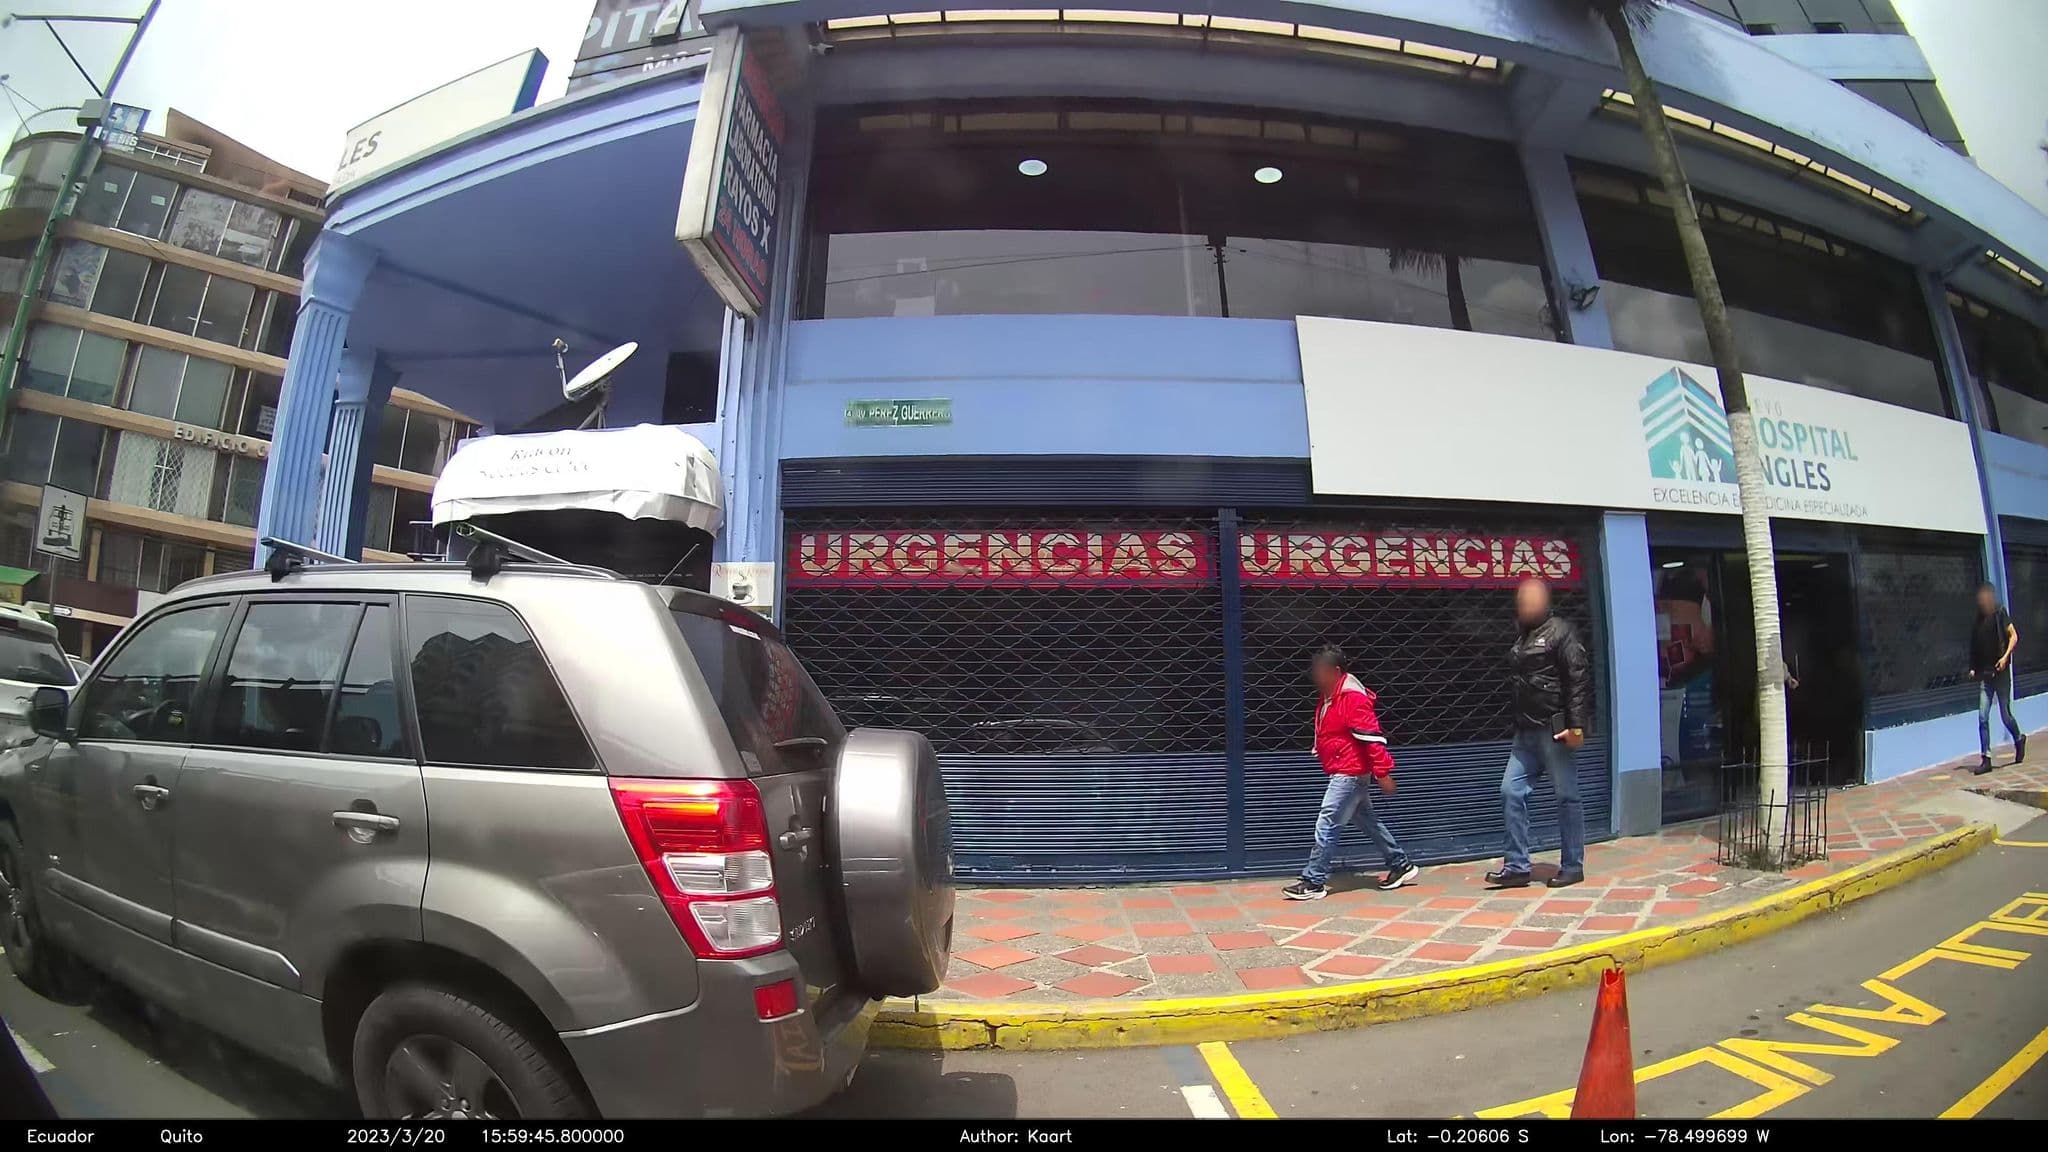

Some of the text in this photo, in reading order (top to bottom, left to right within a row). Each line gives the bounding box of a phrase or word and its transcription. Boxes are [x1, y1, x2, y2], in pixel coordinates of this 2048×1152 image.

[734, 83, 778, 184] FARMACIA
[728, 114, 776, 217] LABORATORIO
[723, 156, 771, 254] RAYOS X
[1752, 416, 1858, 461] OSPITAL
[1759, 454, 1832, 492] NGLES
[1653, 487, 1731, 507] EXCELENCIA
[1732, 492, 1742, 508] E
[800, 532, 1198, 577] URGENCIAS
[1239, 533, 1573, 579] URGENCIAS
